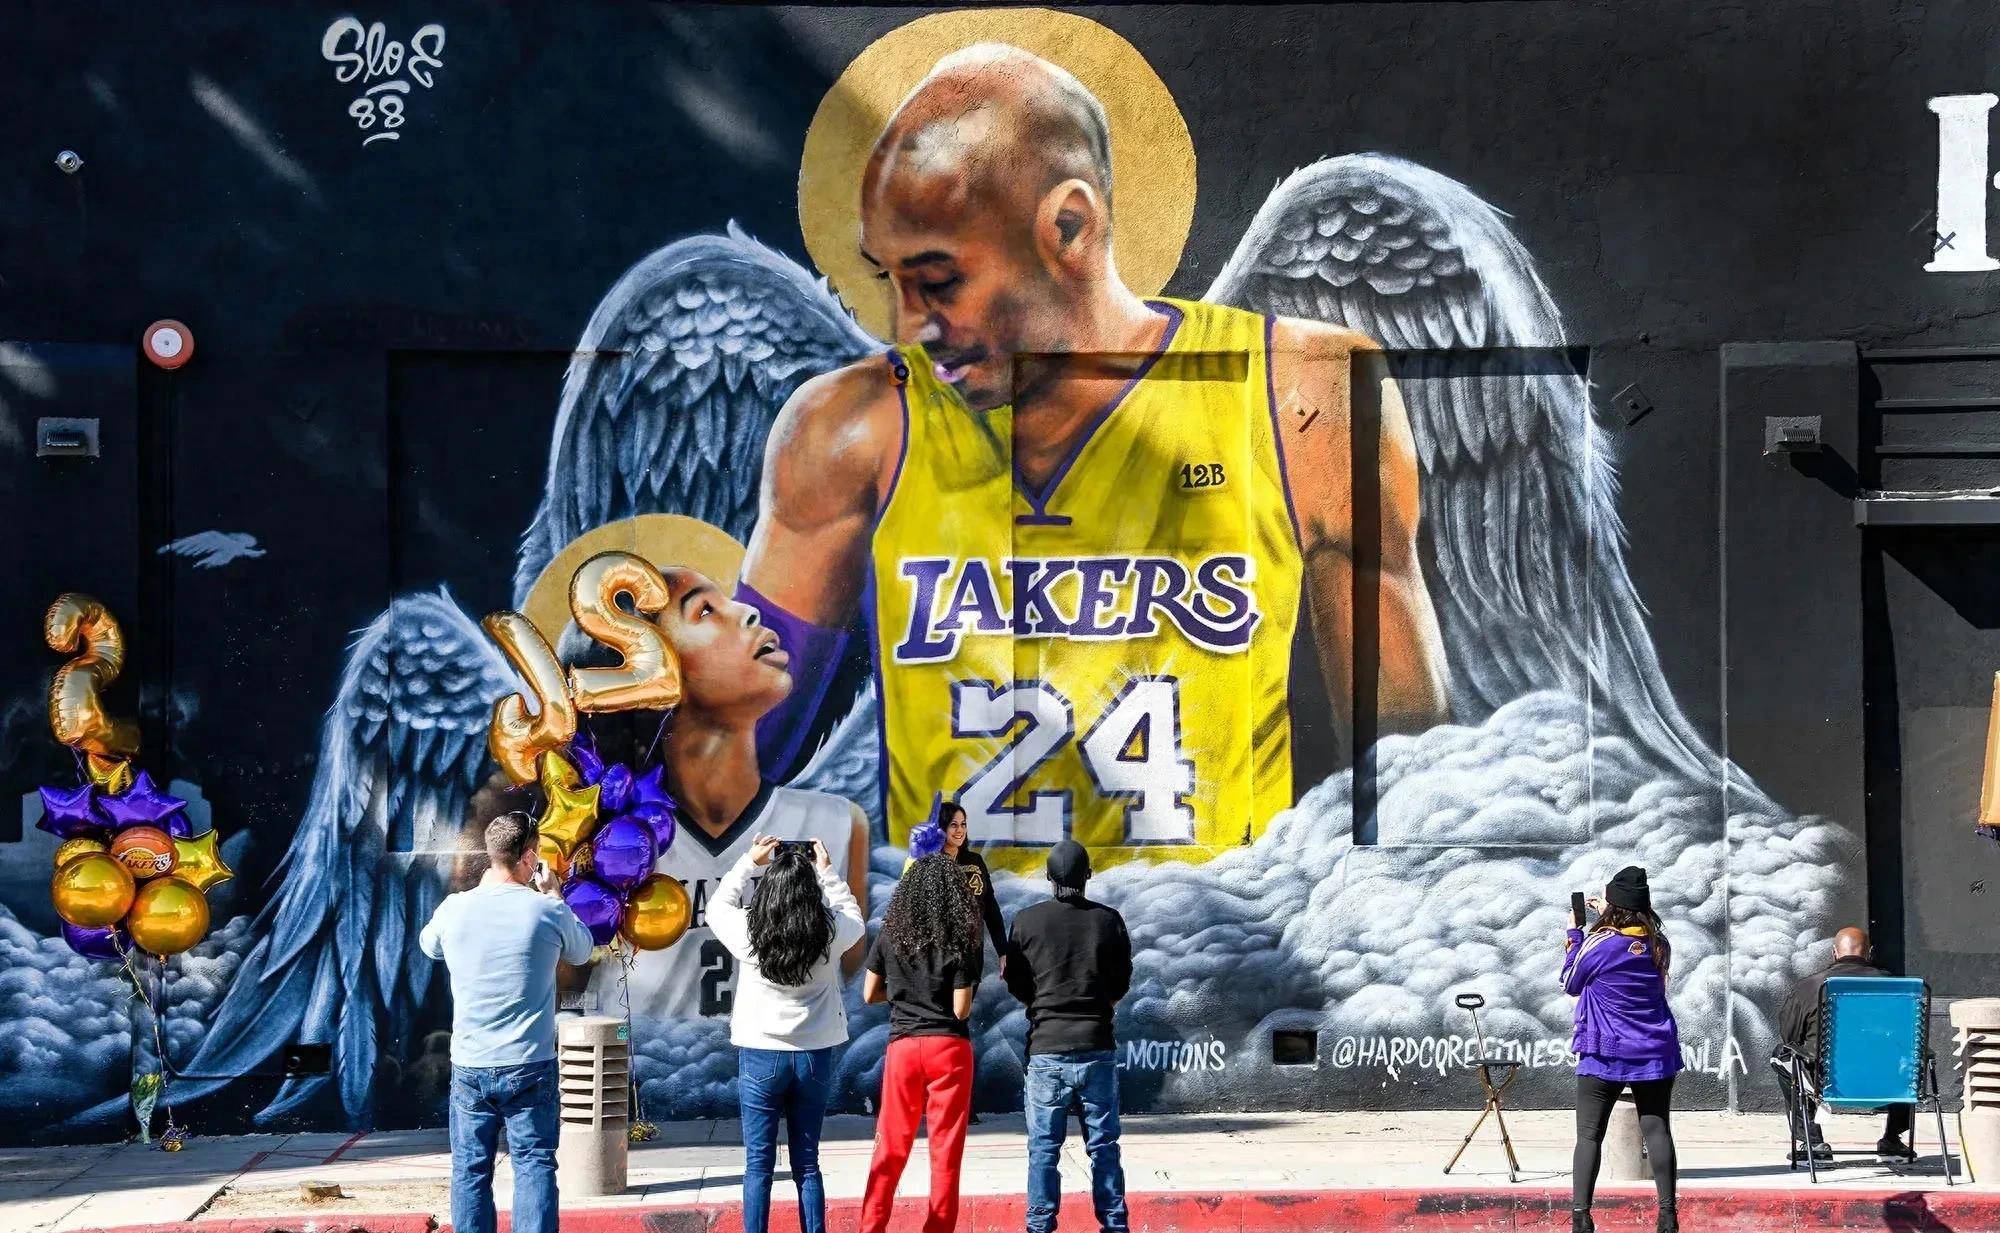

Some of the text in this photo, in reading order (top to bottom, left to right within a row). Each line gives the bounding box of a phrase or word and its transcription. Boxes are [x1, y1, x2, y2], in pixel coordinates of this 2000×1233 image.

[348, 94, 405, 129] 88
[1180, 463, 1226, 488] 12B
[893, 554, 1264, 665] LAKERS
[949, 674, 1196, 848] 24
